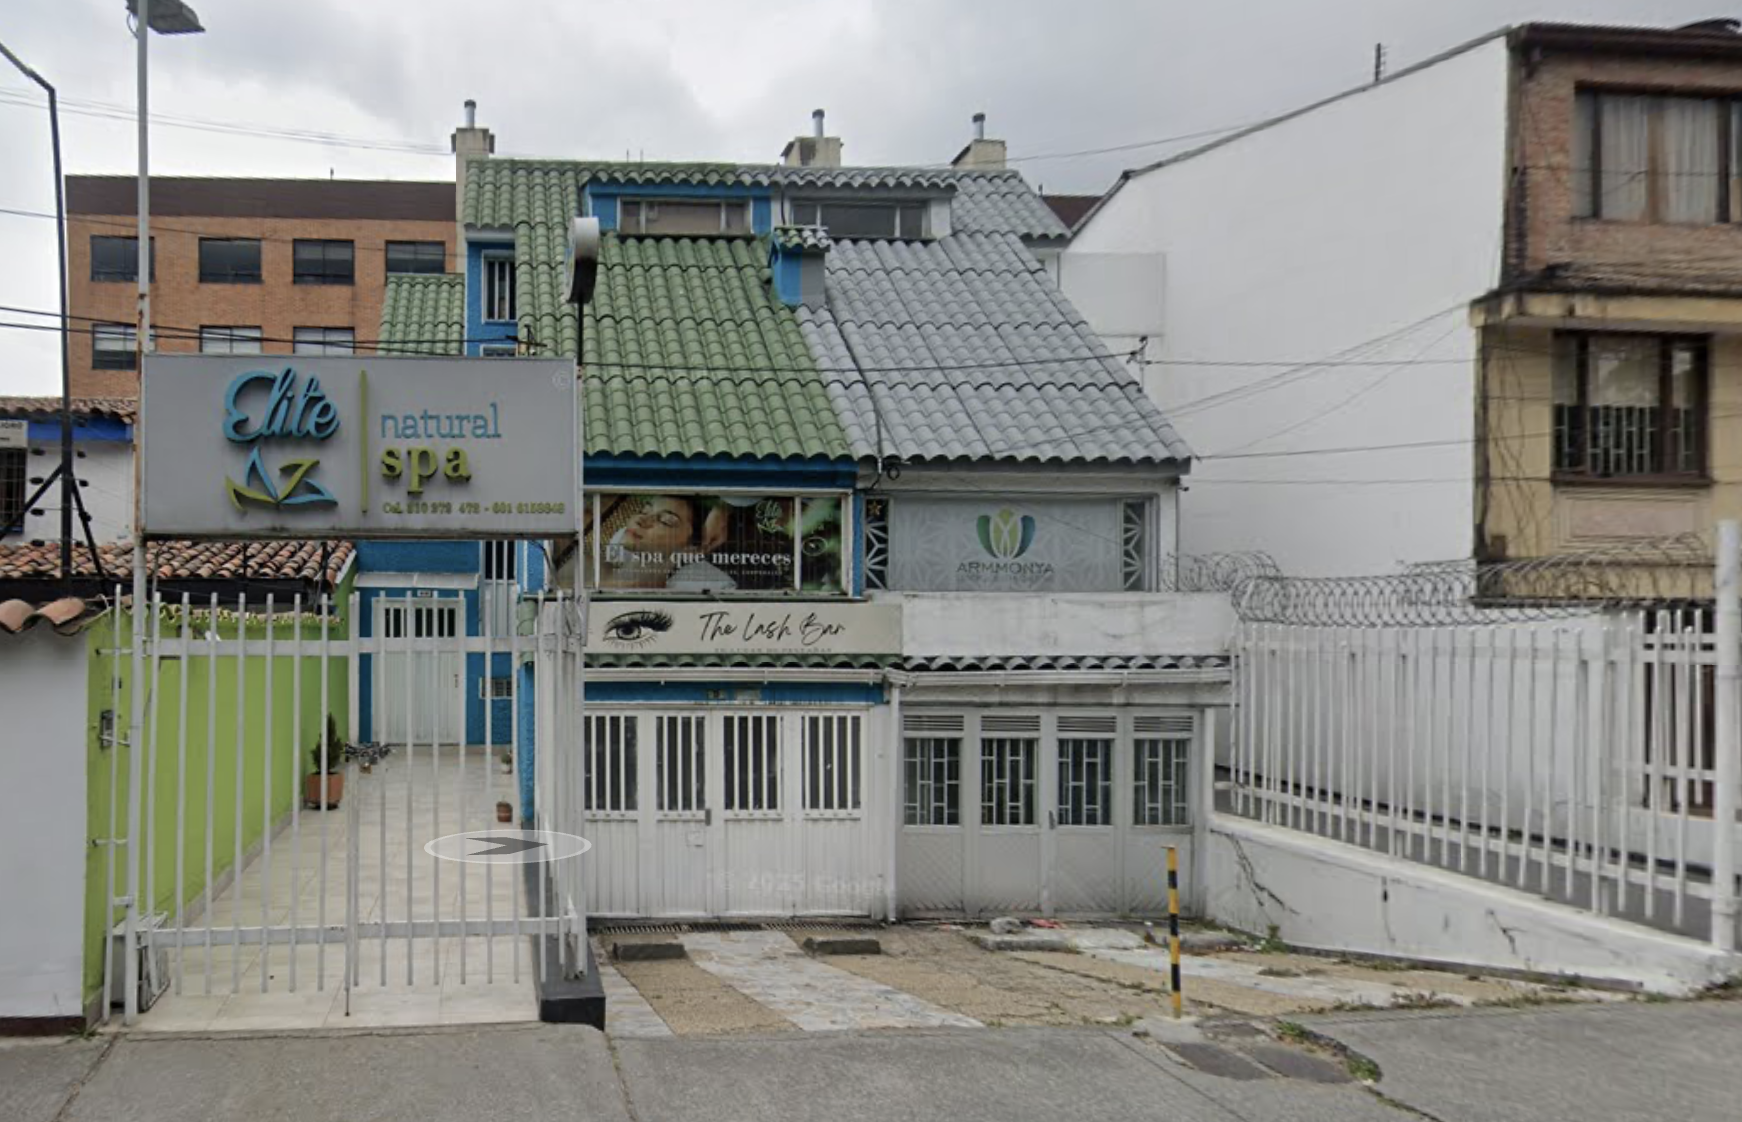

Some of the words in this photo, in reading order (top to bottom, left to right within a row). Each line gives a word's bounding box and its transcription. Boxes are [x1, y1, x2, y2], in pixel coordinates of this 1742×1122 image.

[223, 366, 341, 444] Elite
[380, 402, 502, 440] natural
[380, 446, 472, 494] spa
[605, 546, 625, 563] El
[632, 552, 664, 567] spa
[669, 551, 706, 568] que
[711, 549, 792, 565] mereces
[956, 562, 1055, 575] ARMMONYA
[699, 610, 738, 642] The
[741, 613, 793, 642] Lash
[800, 611, 847, 646] Bar
